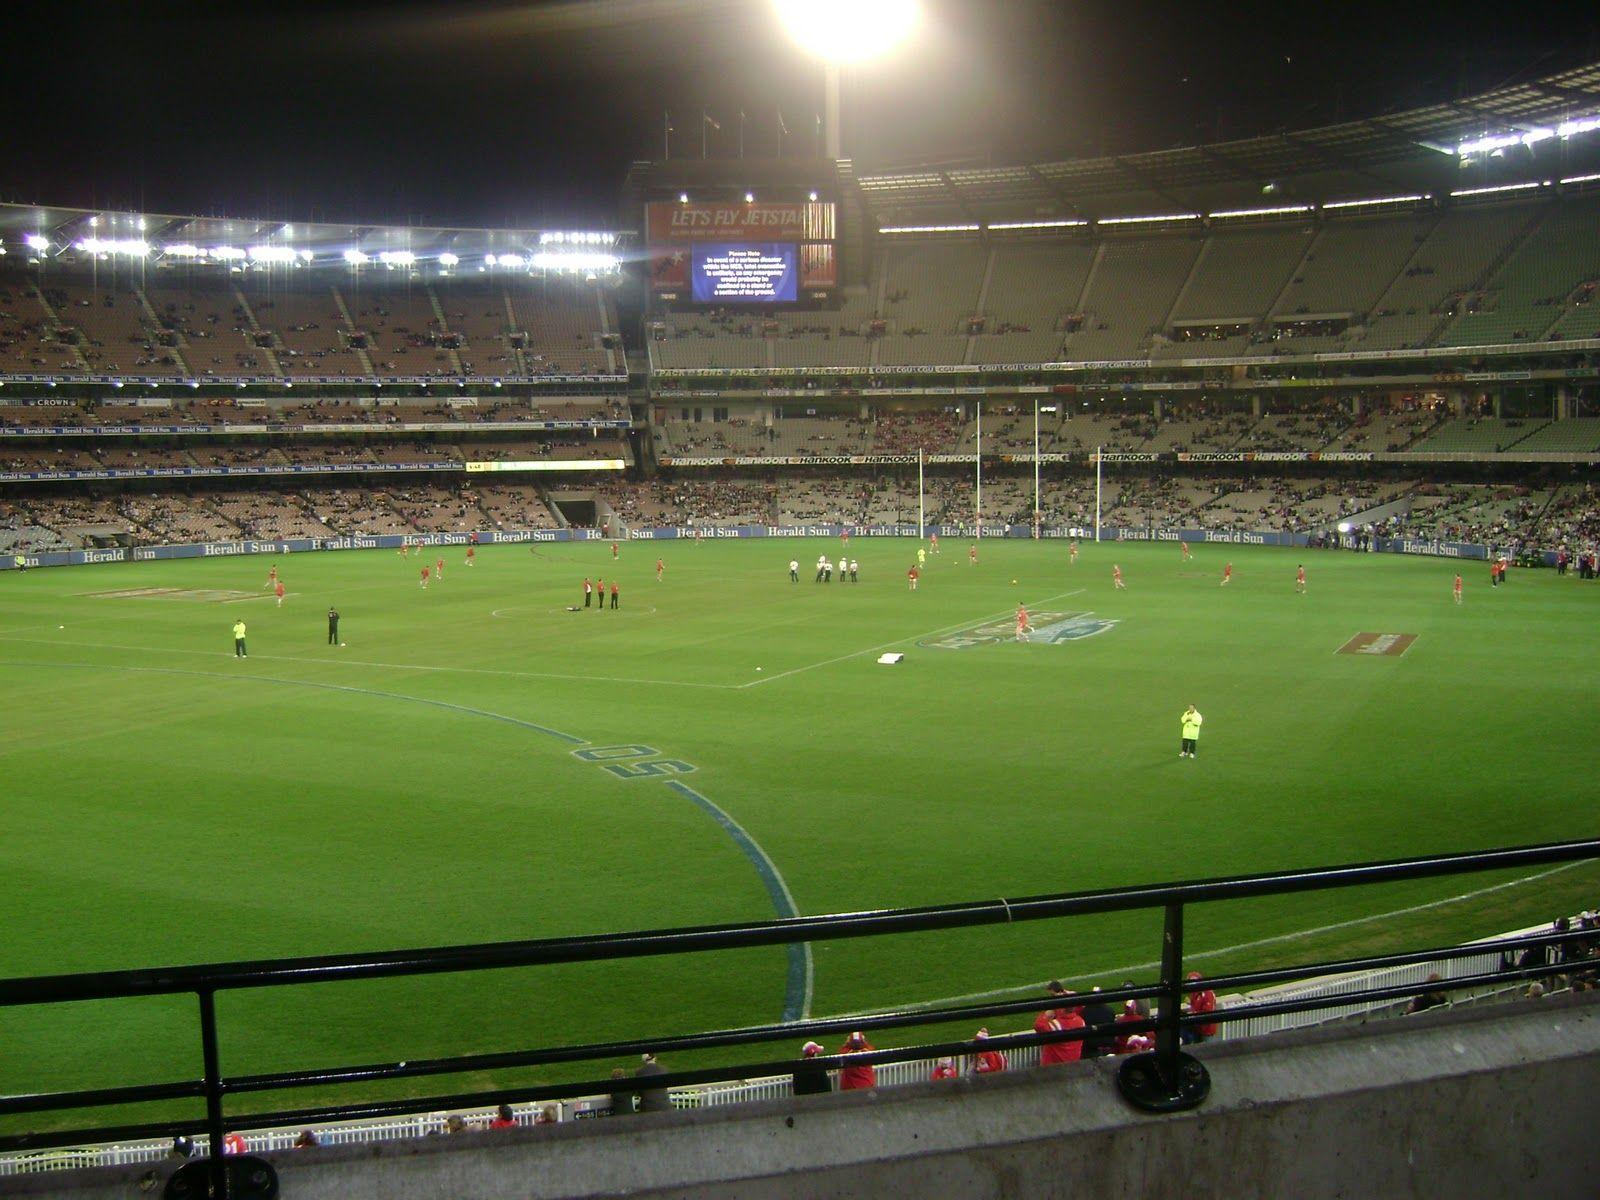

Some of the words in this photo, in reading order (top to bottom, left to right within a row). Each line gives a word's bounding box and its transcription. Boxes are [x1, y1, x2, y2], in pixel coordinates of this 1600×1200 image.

[714, 210, 740, 226] FLY
[493, 532, 530, 542] Herald
[534, 531, 555, 541] Sun
[632, 529, 653, 539] Sun
[717, 528, 738, 537] Sun
[768, 527, 805, 536] Herald
[808, 526, 830, 536] Sun
[982, 526, 1003, 536] Sun
[1158, 530, 1178, 540] Sun
[444, 534, 466, 544] Sun
[1205, 531, 1240, 542] Herald
[1243, 533, 1264, 544] Sun
[205, 544, 244, 555] Herald
[251, 542, 275, 552] Sun
[312, 538, 351, 550] Hrald
[354, 538, 376, 548] Sun
[1403, 540, 1437, 554] Herald
[1439, 543, 1458, 556] Sun
[14, 556, 39, 567] un
[83, 550, 124, 563] Herald
